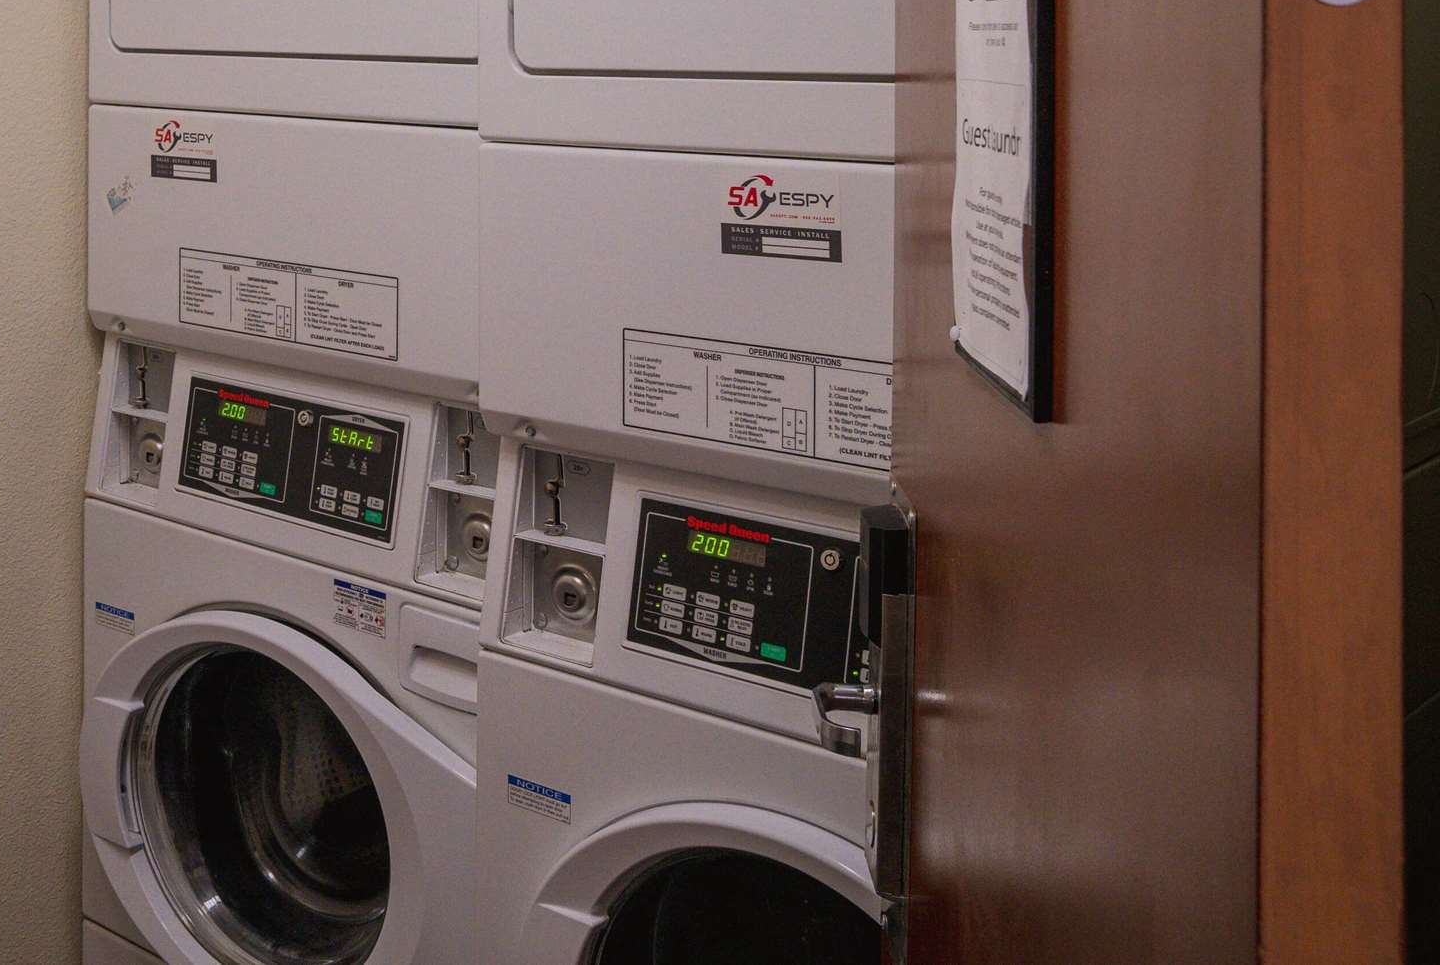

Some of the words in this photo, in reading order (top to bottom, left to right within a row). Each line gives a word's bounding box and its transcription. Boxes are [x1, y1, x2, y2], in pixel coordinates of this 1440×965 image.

[779, 192, 835, 209] ESPY
[760, 228, 792, 237] SERVICE
[797, 231, 831, 239] INSTALL
[693, 350, 721, 361] WASHER
[748, 347, 787, 359] OPERATING
[789, 352, 841, 366] INSTRUCTIONS
[687, 515, 727, 534] Speed
[729, 523, 770, 544] Queen
[516, 779, 563, 799] NOTICE
